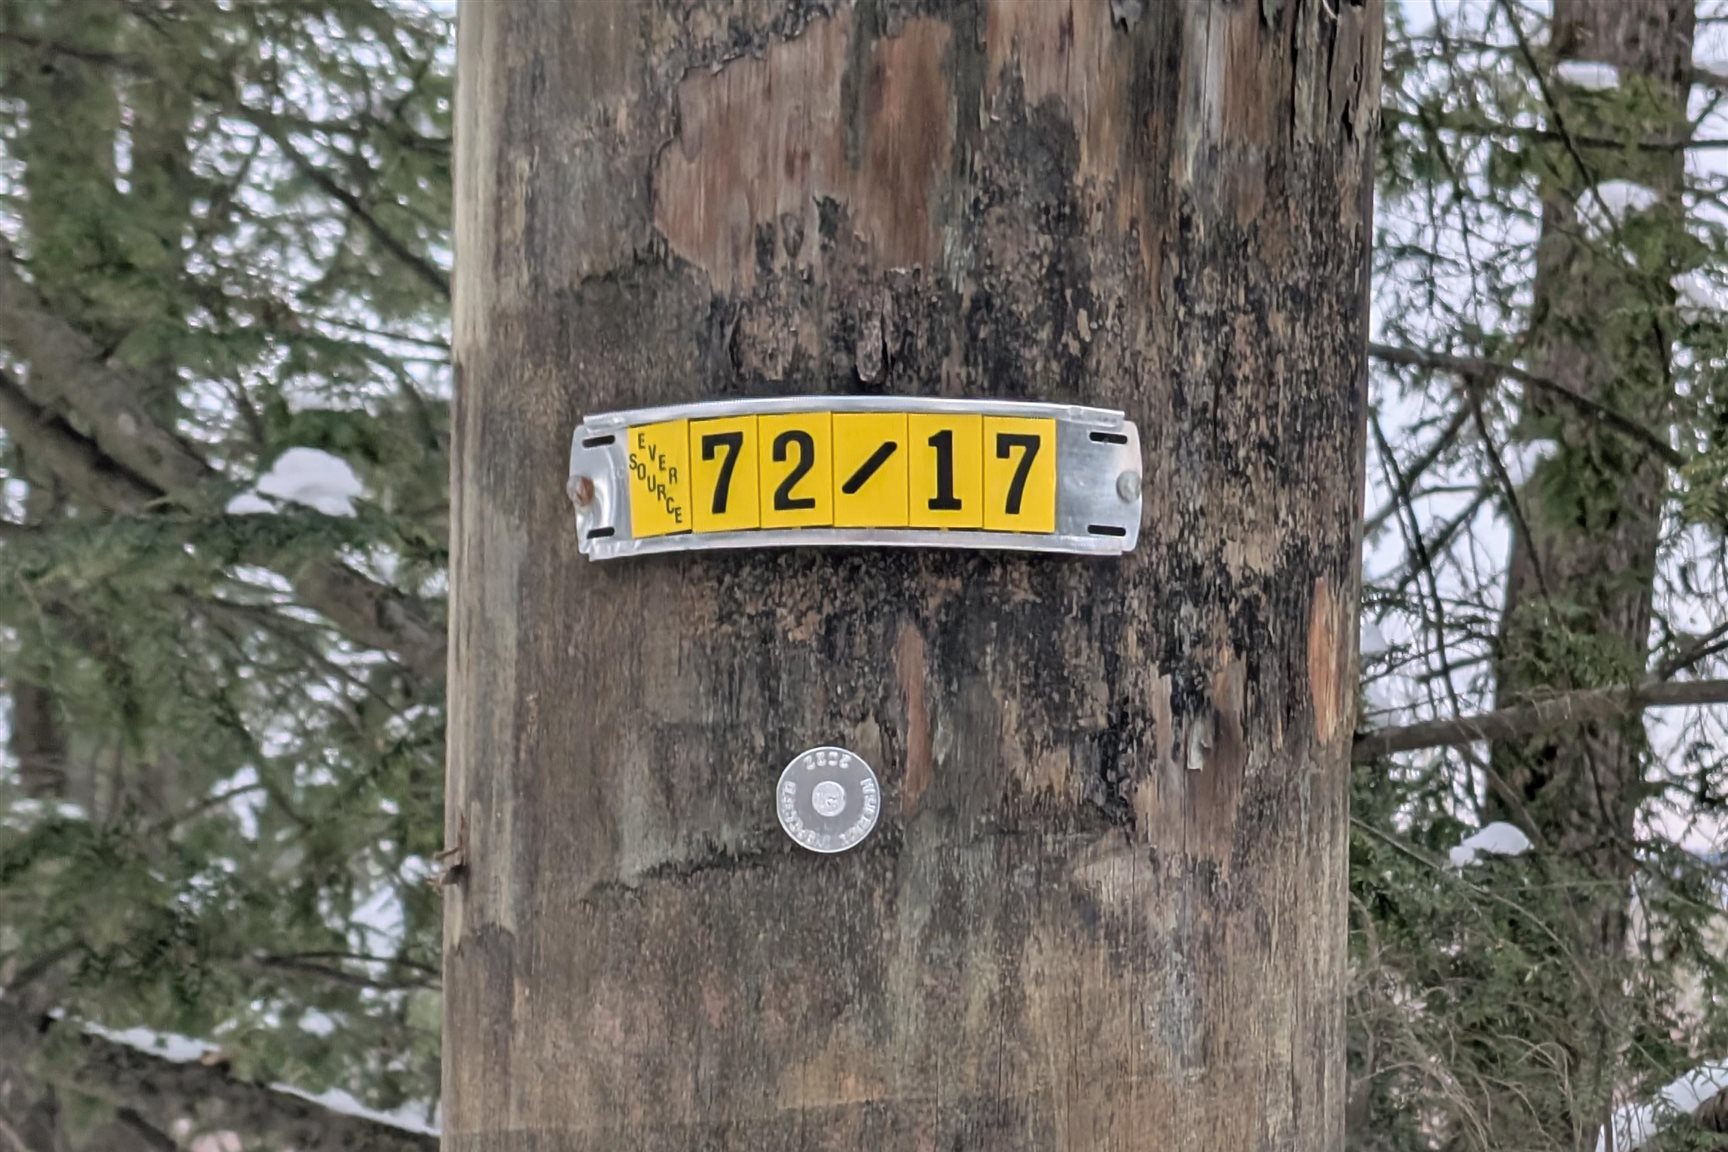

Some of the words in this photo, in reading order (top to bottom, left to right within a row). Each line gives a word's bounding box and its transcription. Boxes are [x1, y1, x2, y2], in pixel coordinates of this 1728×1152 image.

[629, 454, 683, 525] SOURCE
[638, 433, 678, 484] EVER
[701, 430, 1041, 515] 72/17
